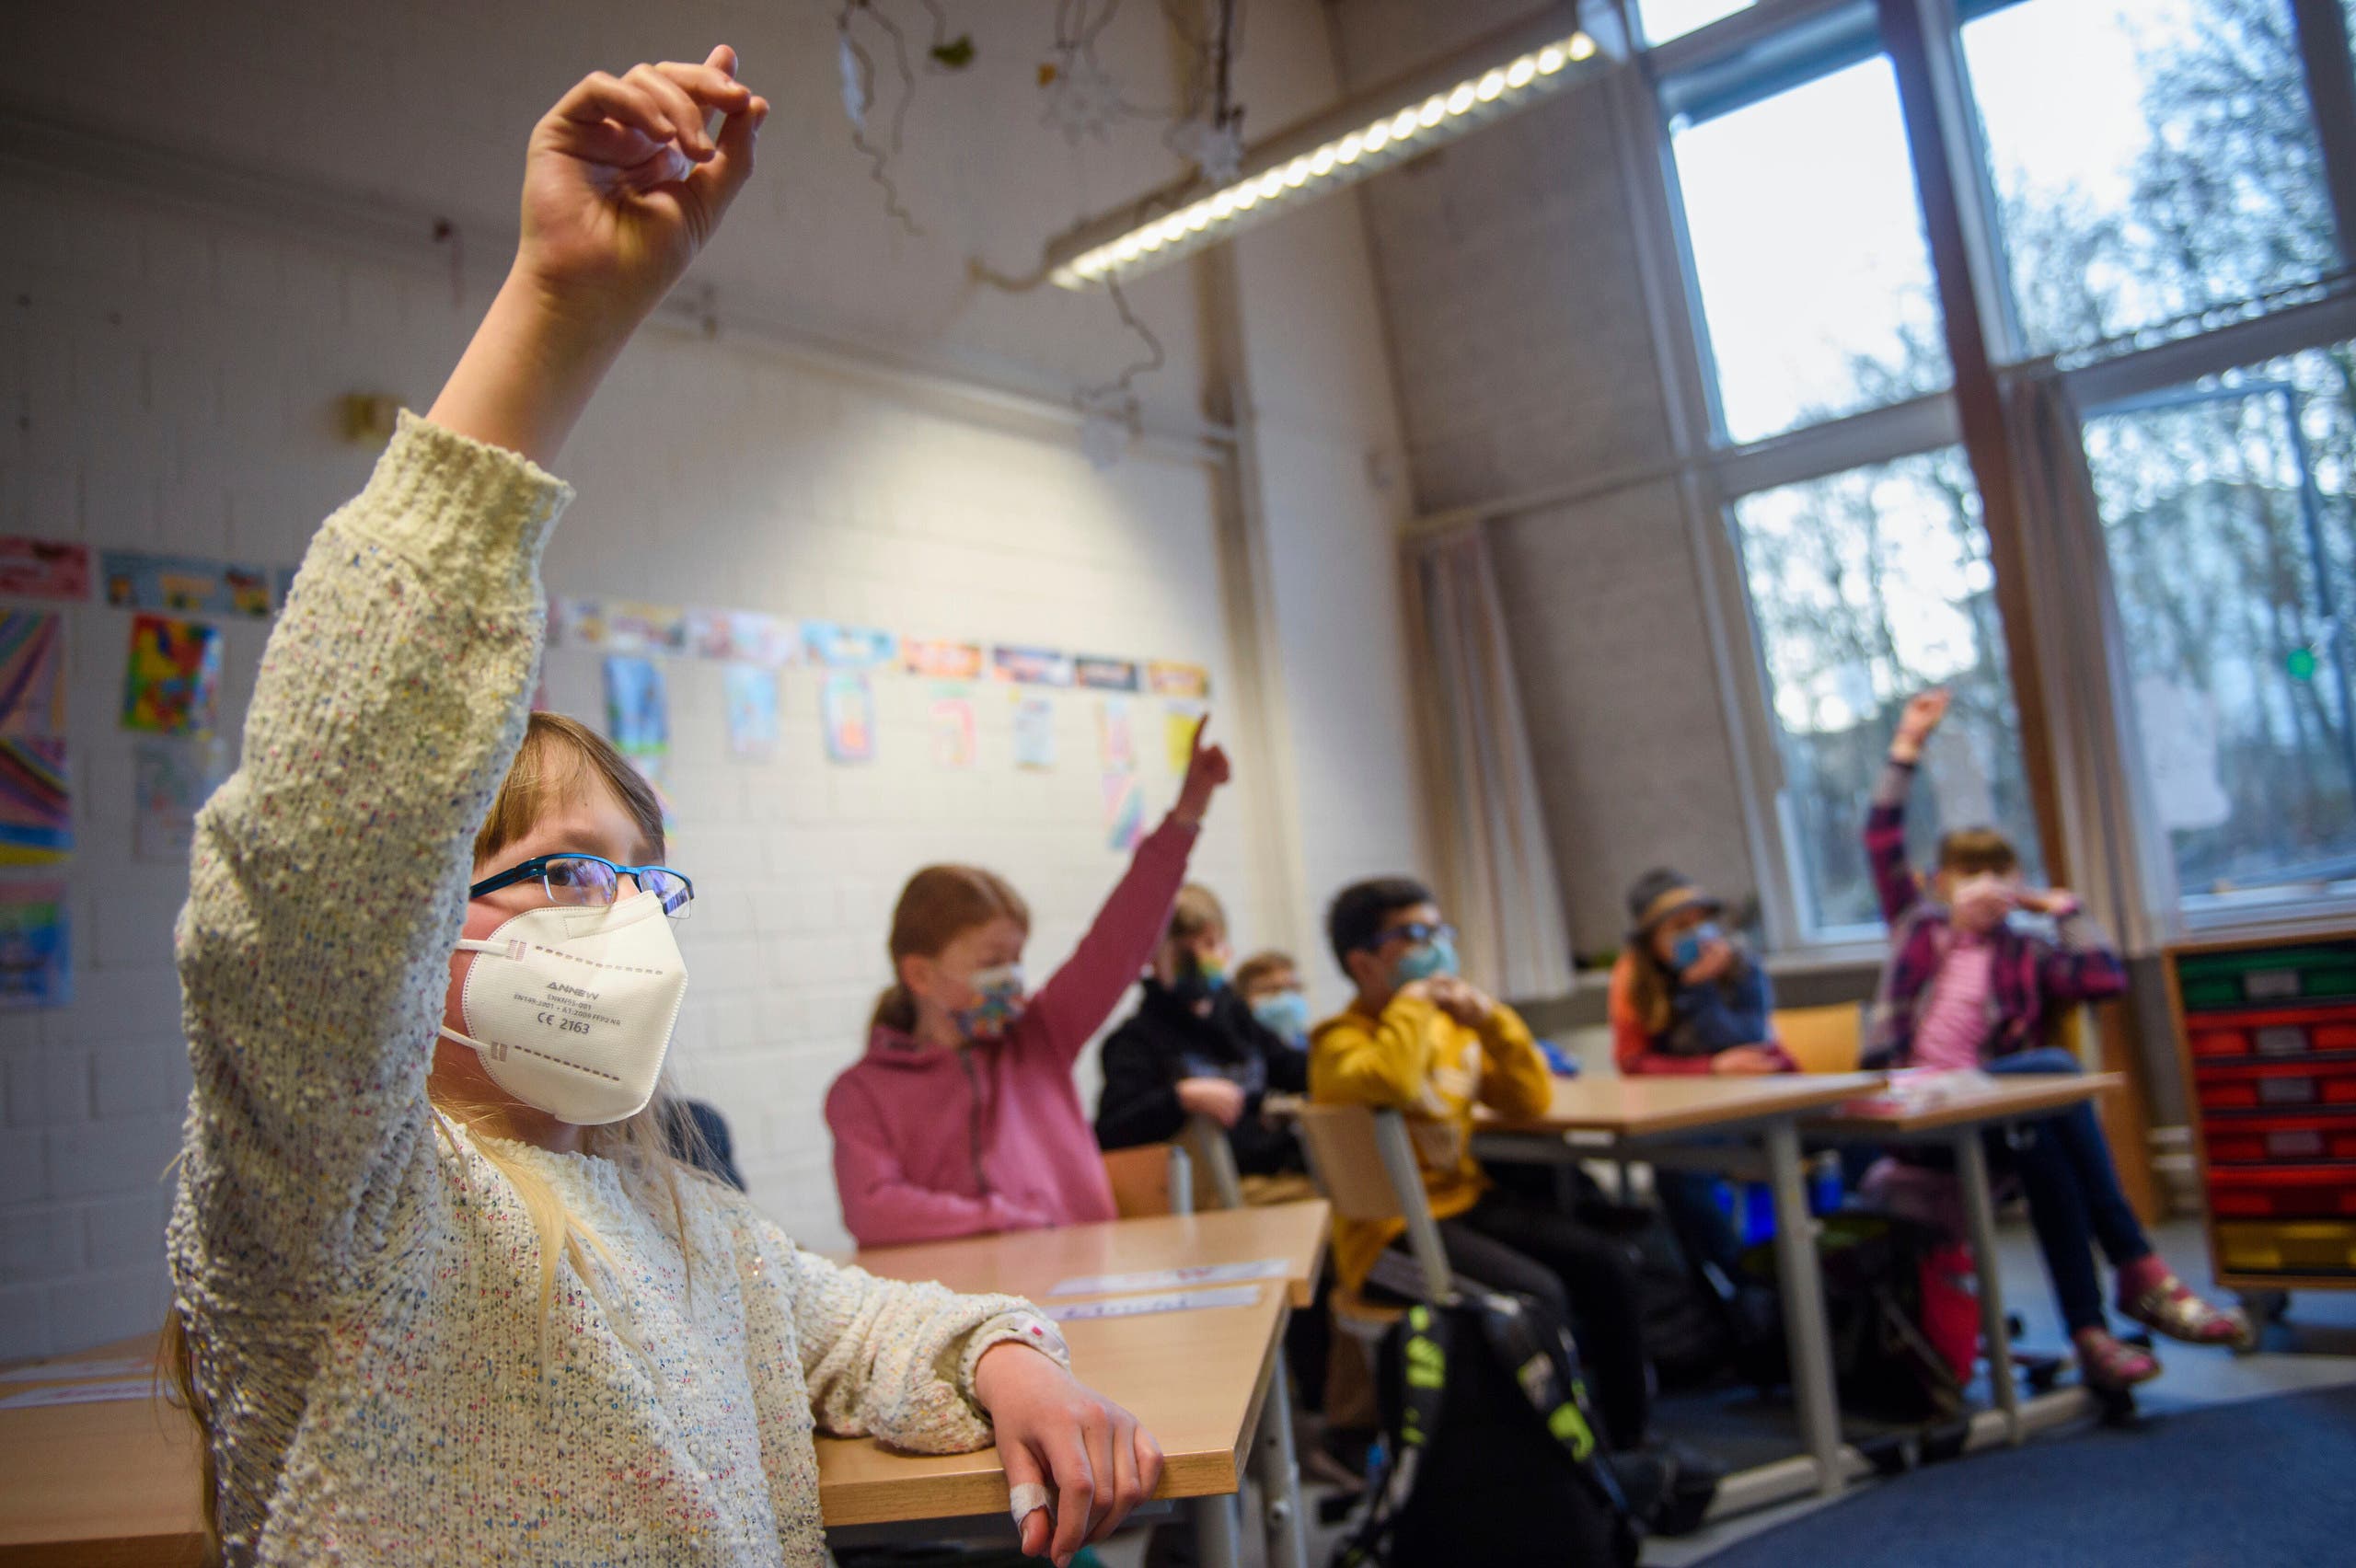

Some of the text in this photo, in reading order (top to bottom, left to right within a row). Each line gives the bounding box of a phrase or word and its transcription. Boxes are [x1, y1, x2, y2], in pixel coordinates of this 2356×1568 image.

[548, 982, 599, 1000] ANNEW
[537, 1012, 590, 1034] CE 2163
